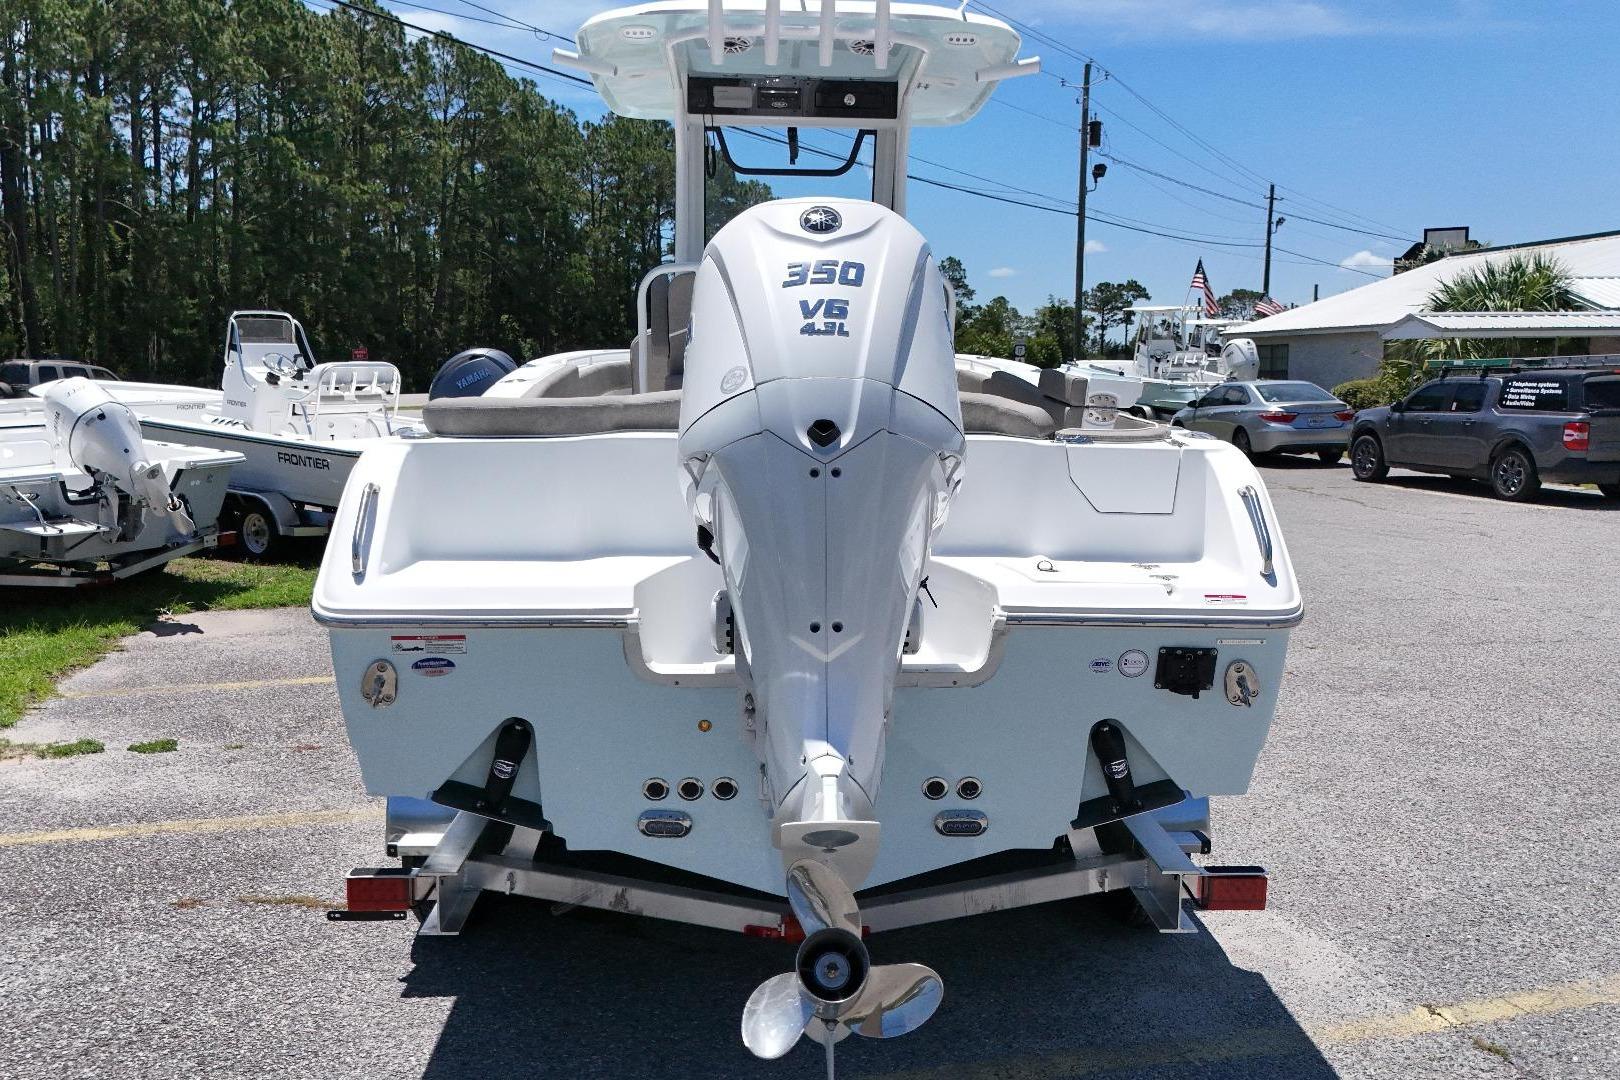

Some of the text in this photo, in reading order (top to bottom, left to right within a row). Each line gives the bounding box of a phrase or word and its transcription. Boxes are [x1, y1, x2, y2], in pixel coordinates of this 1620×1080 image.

[782, 259, 865, 288] 350
[799, 298, 850, 320] V6
[456, 367, 490, 389] YAMAHA
[176, 402, 206, 411] FRONTIER
[277, 451, 330, 471] FRONTIER
